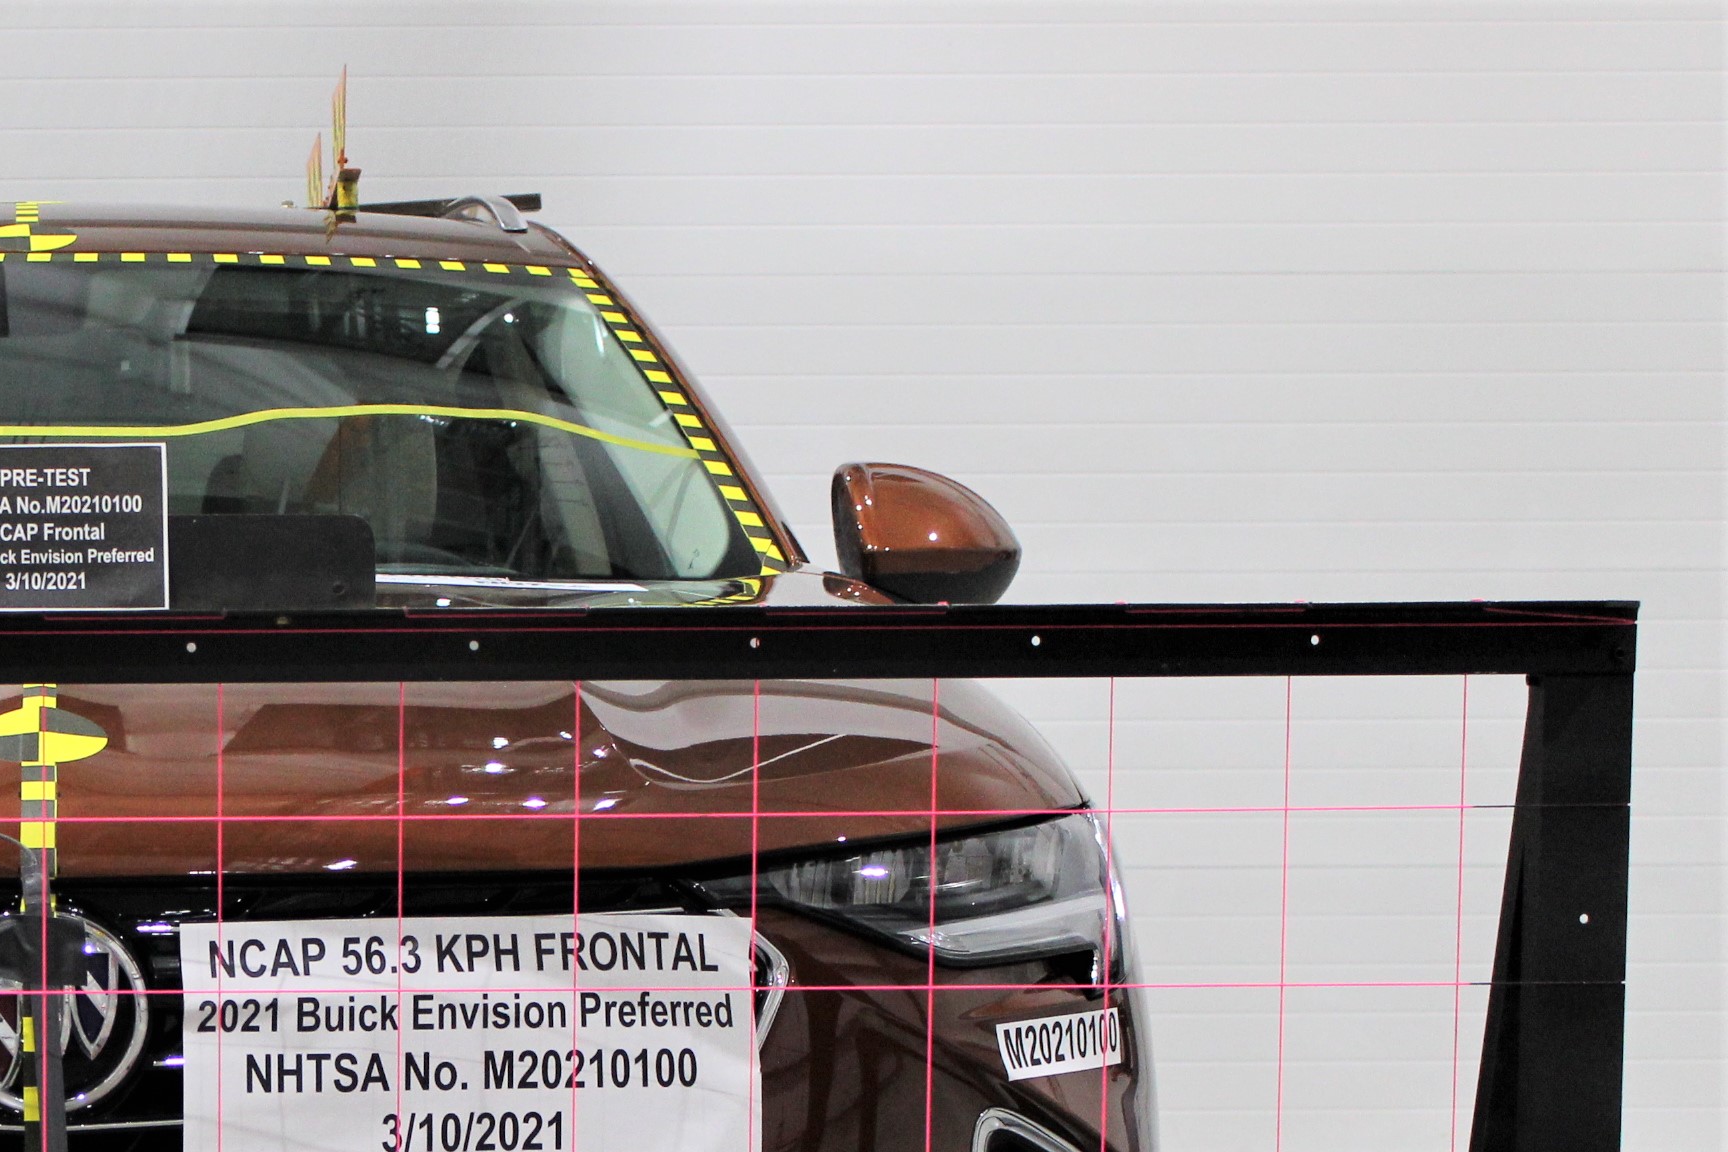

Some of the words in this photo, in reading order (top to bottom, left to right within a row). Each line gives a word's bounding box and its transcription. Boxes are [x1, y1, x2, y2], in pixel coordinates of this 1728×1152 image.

[0, 468, 91, 487] PRE-TEST
[16, 495, 142, 514] No.M20210100
[43, 522, 105, 541] Frontal
[20, 548, 83, 564] Envision
[87, 547, 154, 563] Preferred
[5, 572, 86, 590] 3/10/2021
[209, 938, 326, 979] NCAP
[342, 936, 422, 975] 56.3
[436, 933, 521, 973] KPH
[536, 931, 719, 972] FRONTAL
[197, 999, 278, 1033] 2021
[297, 995, 400, 1032] Buick
[413, 993, 567, 1031] Envision
[580, 992, 734, 1028] Preferred
[1003, 1012, 1117, 1070] M20210100
[246, 1052, 390, 1093] NHTSA
[404, 1052, 469, 1092] No.
[483, 1048, 697, 1090] M20210100
[382, 1112, 563, 1152] 3/10/2021
